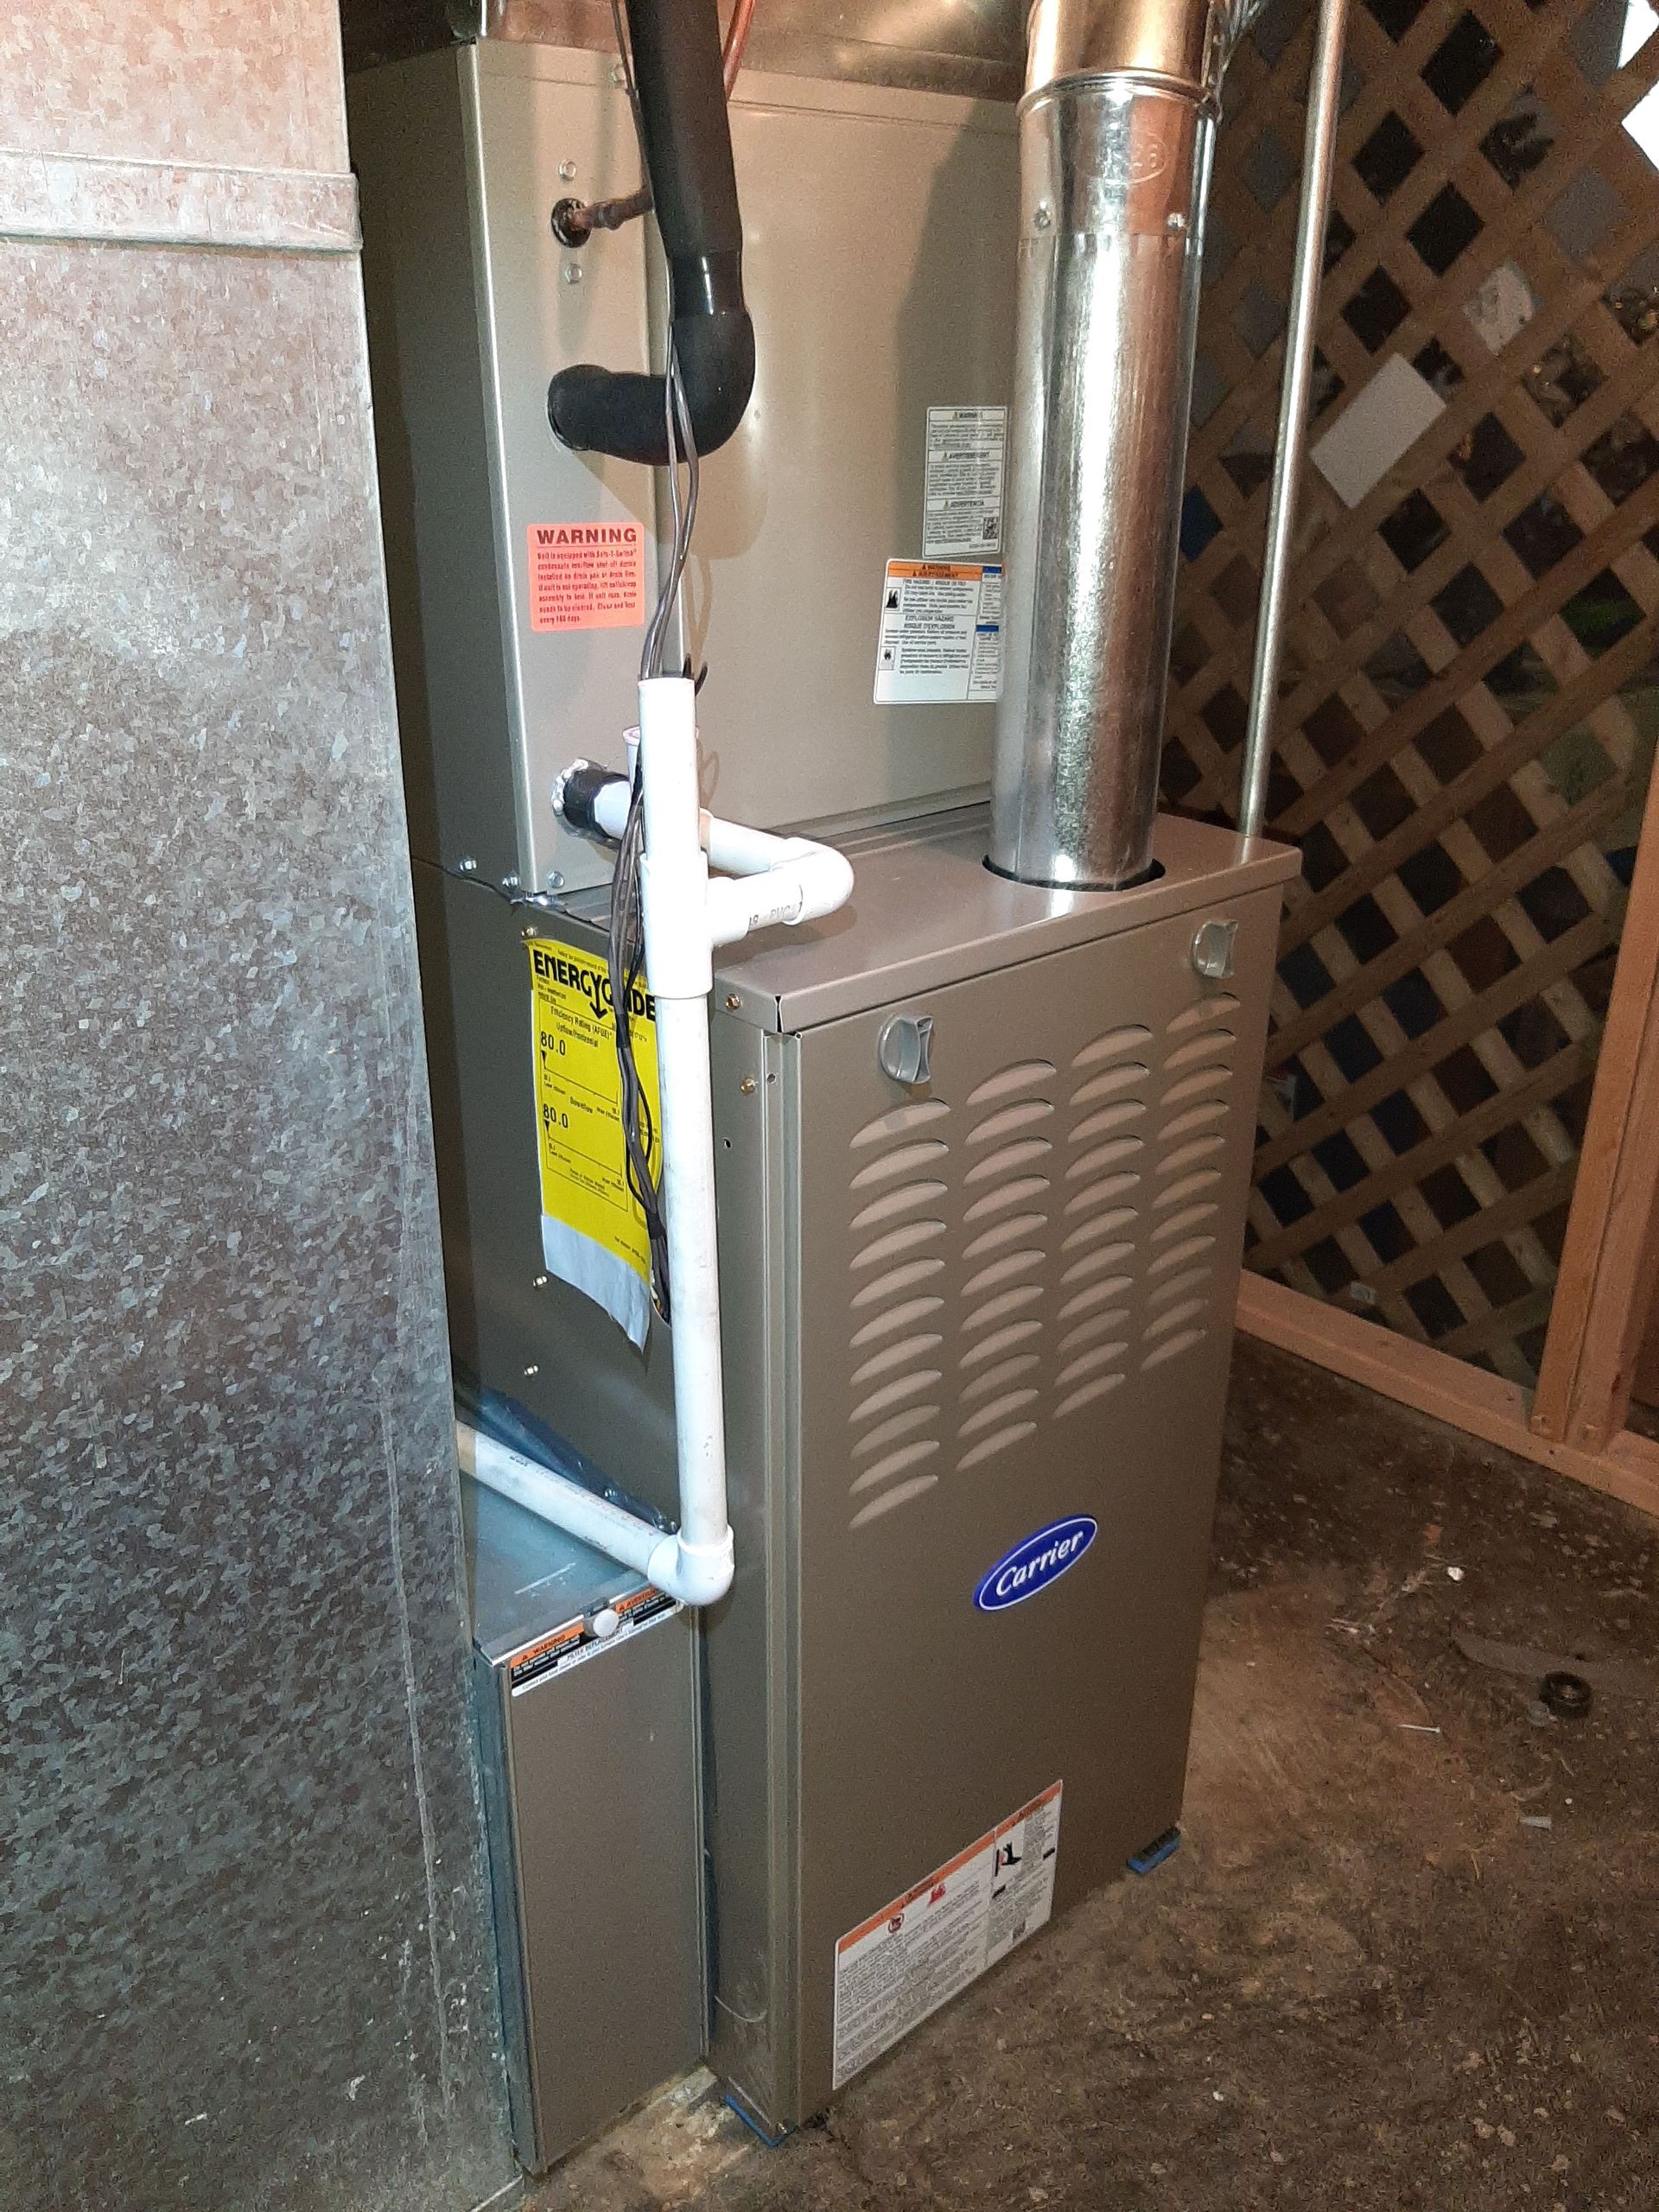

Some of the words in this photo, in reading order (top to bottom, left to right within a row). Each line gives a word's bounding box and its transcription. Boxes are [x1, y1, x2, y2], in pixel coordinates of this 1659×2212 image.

[537, 528, 637, 544] WARNING
[540, 1032, 566, 1057] 80.0
[543, 1103, 569, 1129] 80.0
[995, 1530, 1084, 1597] Carrier
[532, 1634, 566, 1655] WARNING
